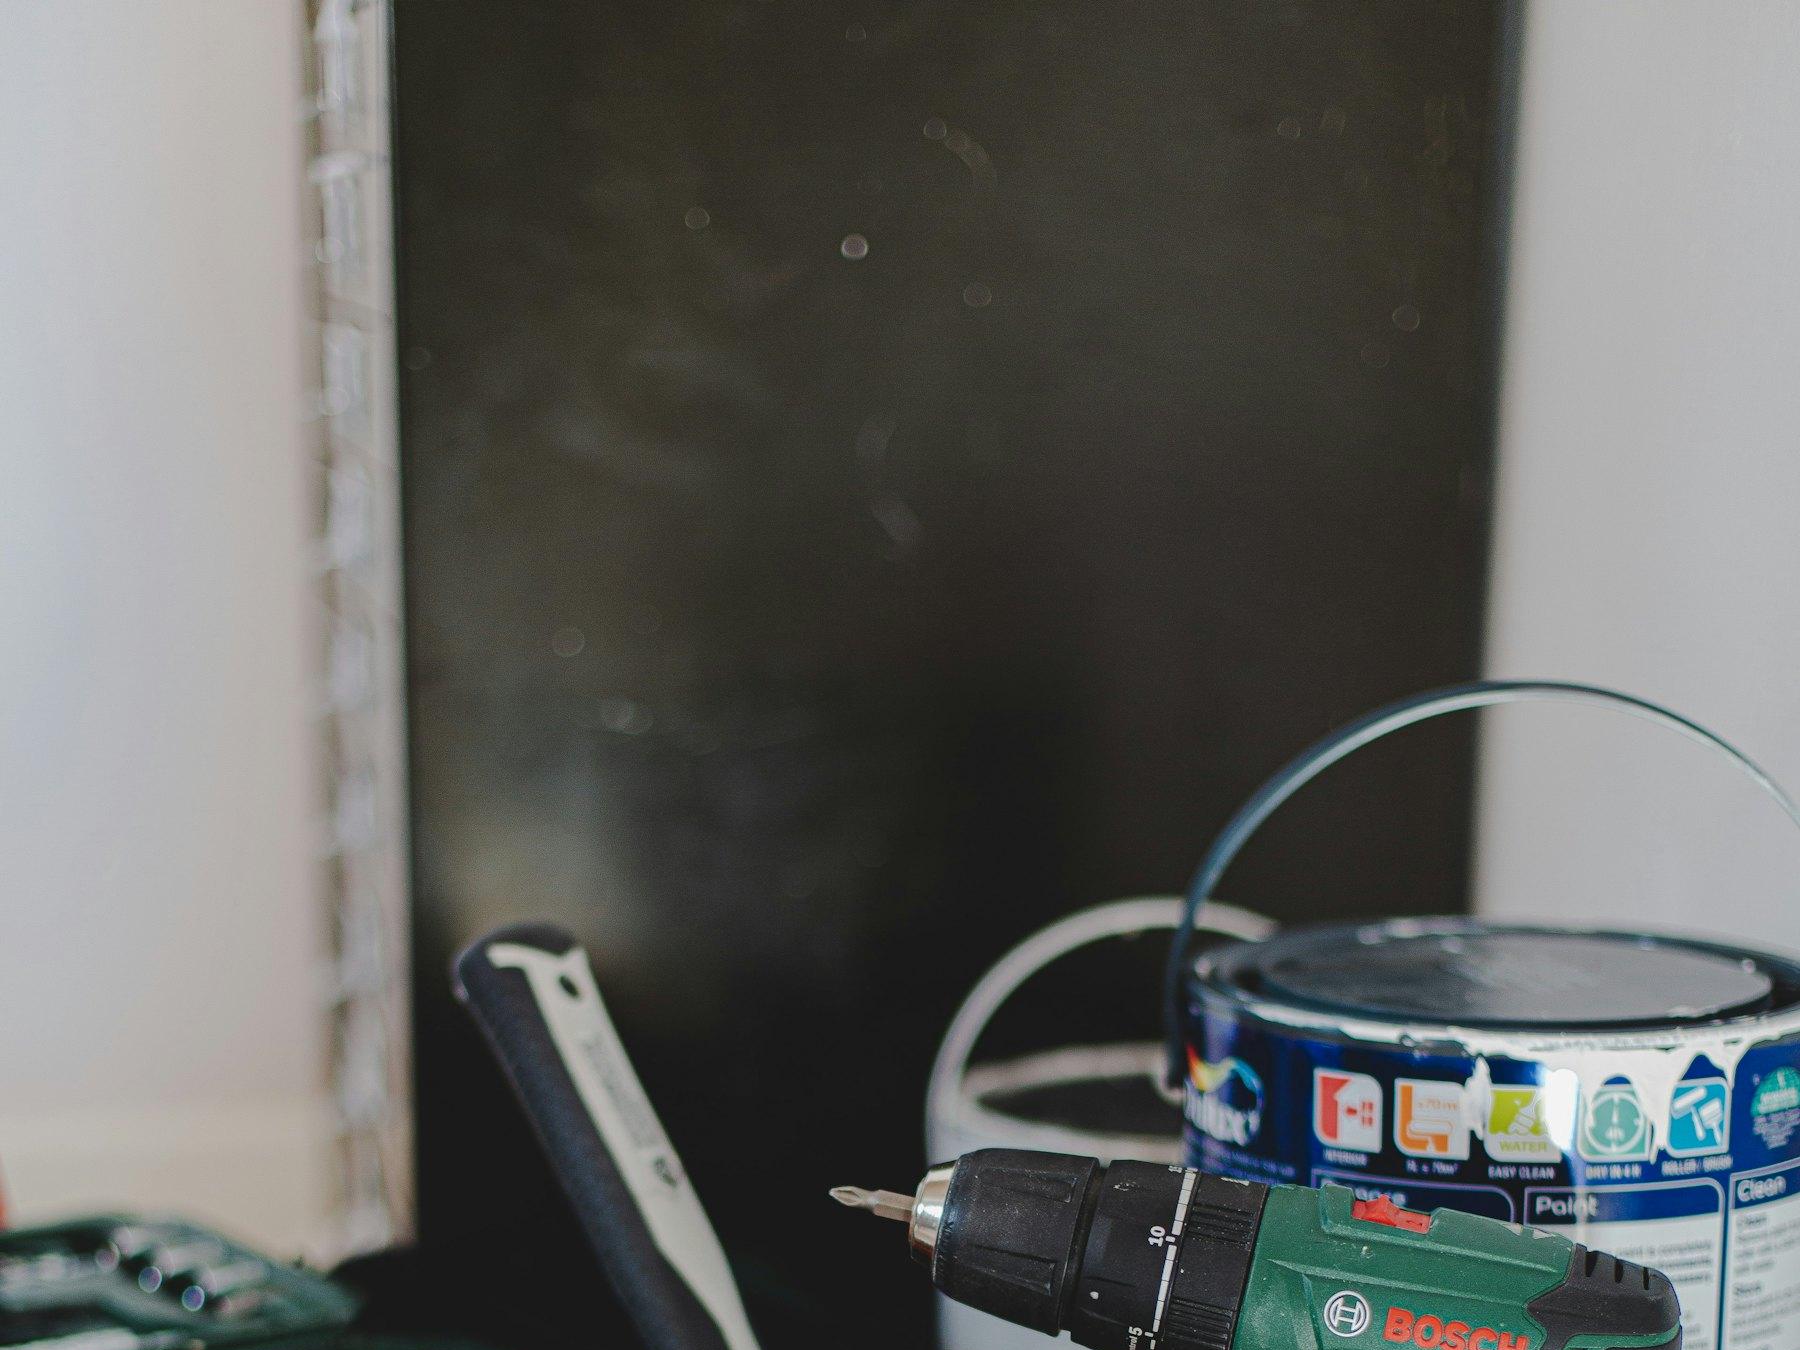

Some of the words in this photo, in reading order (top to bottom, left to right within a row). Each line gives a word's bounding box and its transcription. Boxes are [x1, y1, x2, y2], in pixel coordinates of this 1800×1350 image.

[1499, 1141, 1548, 1153] WATER
[1487, 1165, 1517, 1178] EASY
[1519, 1165, 1556, 1179] CLEAN
[1737, 1176, 1786, 1202] Clean
[1148, 1225, 1167, 1247] 10
[1128, 1326, 1143, 1337] 5
